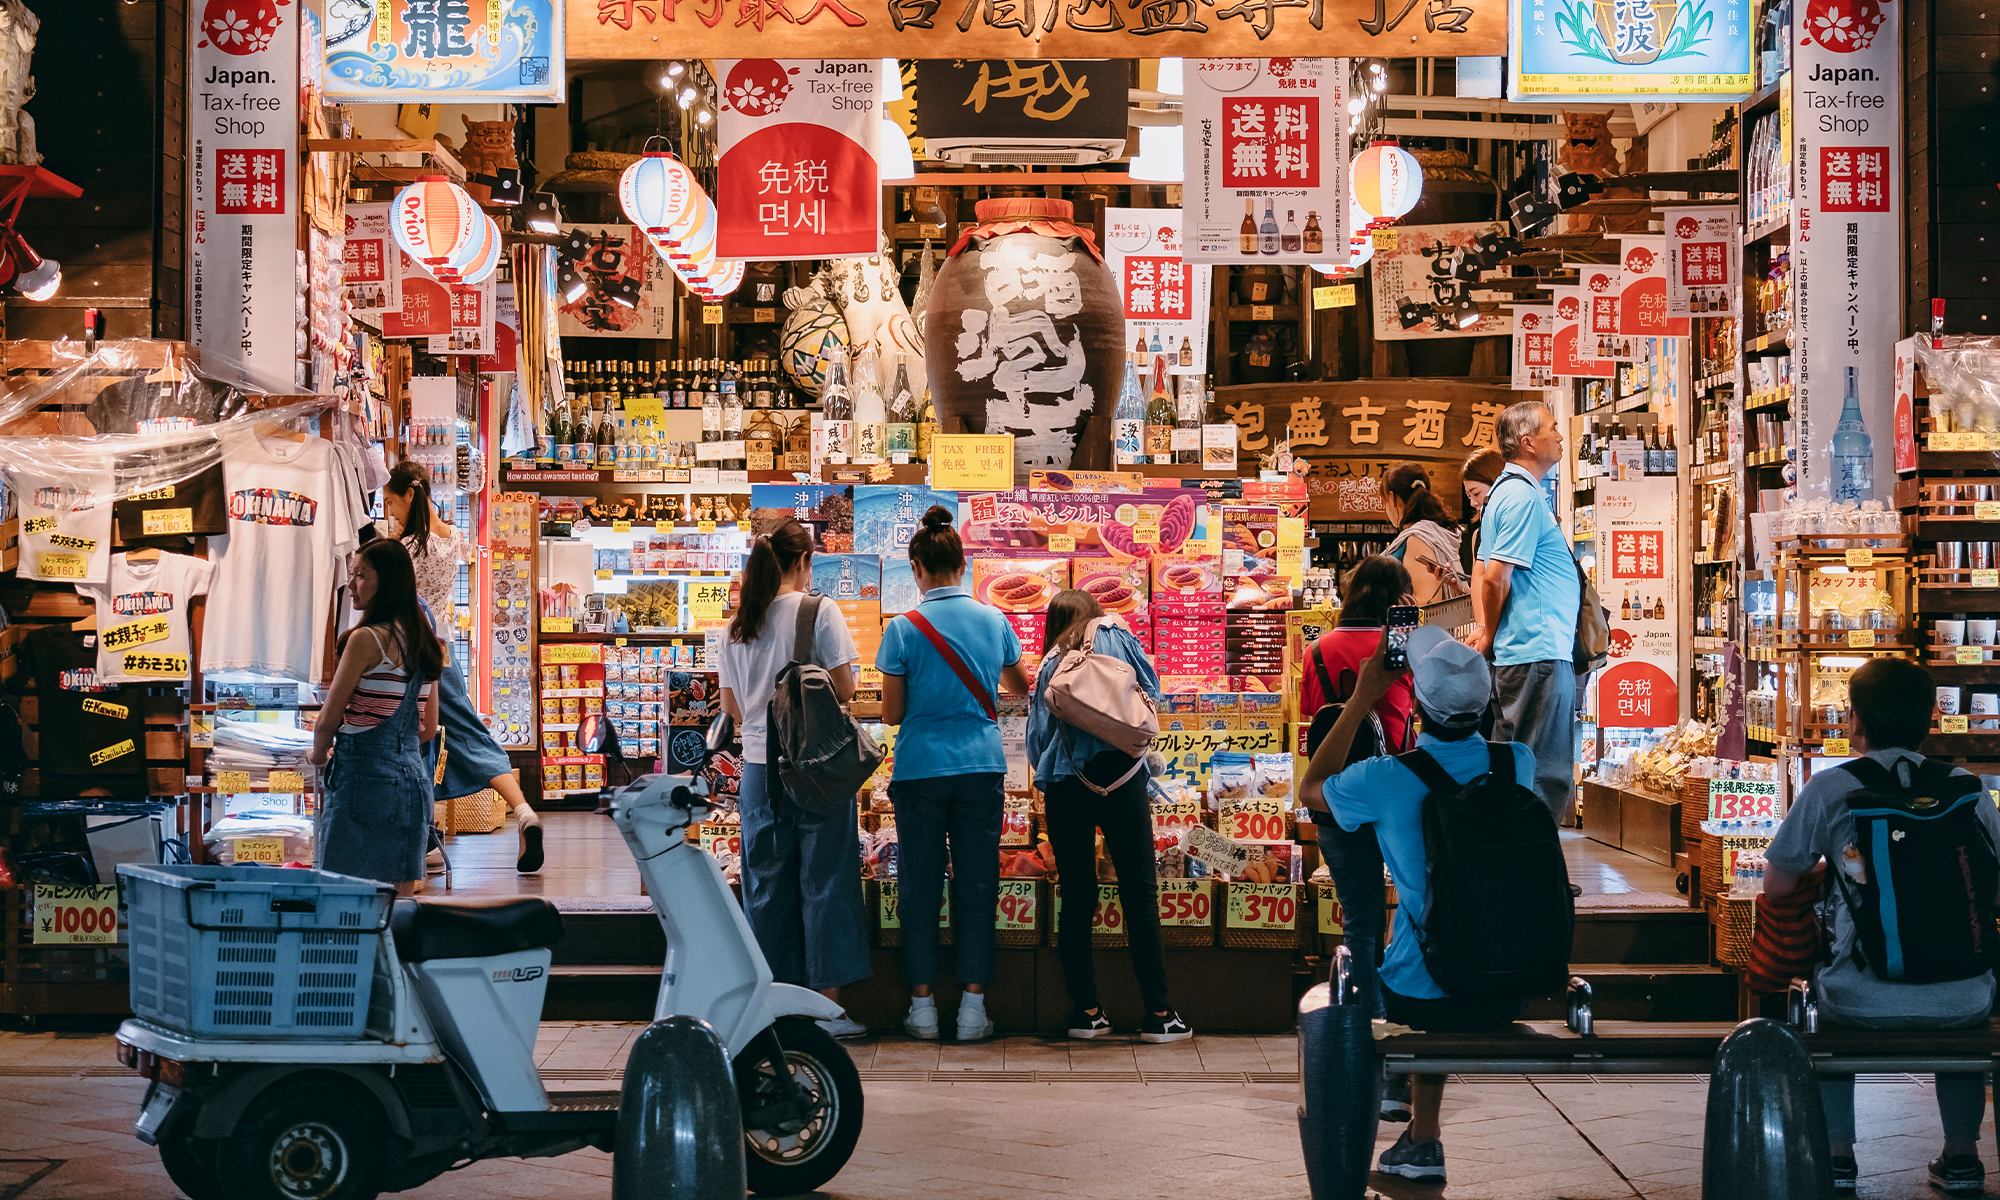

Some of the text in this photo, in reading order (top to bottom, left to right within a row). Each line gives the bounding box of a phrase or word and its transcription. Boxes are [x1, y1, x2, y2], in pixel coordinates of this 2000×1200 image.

[401, 0, 478, 58] 龍
[488, 0, 500, 43] 風味絶佳
[425, 60, 453, 72] たつ
[814, 60, 874, 77] Japan.
[1808, 63, 1880, 86] Japan.
[205, 65, 276, 88] Japan.
[1278, 78, 1317, 89] 免税 면세
[1522, 75, 1545, 83] 製造元
[1670, 75, 1749, 85] 波照間酒造所
[807, 79, 874, 94] Tax-free
[199, 93, 281, 111] Tax-free
[831, 96, 874, 114] Shop
[1803, 90, 1885, 109] Tax-free
[214, 116, 265, 138] Shop
[1231, 103, 1309, 140] 送料
[1818, 113, 1870, 136] Shop
[222, 153, 278, 179] 送料
[1231, 142, 1310, 179] 無料
[1826, 151, 1883, 178] 送料
[757, 159, 830, 196] 免税
[222, 181, 278, 208] 無料
[668, 168, 687, 213] Orion
[1236, 190, 1308, 198] 期間限定キャンペーン中
[1826, 179, 1883, 207] 無料
[404, 196, 425, 247] Orion
[758, 199, 828, 237] 면세
[1686, 245, 1721, 262] 送料
[1130, 260, 1185, 287] 送料
[1686, 263, 1722, 281] 無料
[240, 224, 253, 357] 期間限定キャンペーン中。
[1846, 222, 1859, 355] 期間限定キャンペーン中。
[401, 292, 430, 309] 免税
[1130, 287, 1185, 314] 無料
[401, 311, 430, 328] 면세
[942, 445, 1005, 454] TAX FREE
[941, 459, 1004, 471] 免税 면세
[506, 472, 599, 482] How about awamori tasting?
[1000, 489, 1028, 503] 沖縄
[232, 494, 313, 524] OKINAWA
[794, 490, 811, 522] 沖縄
[898, 491, 914, 522] 沖縄
[971, 496, 996, 521] 元祖
[998, 502, 1112, 526] 紅いもタルト
[146, 522, 180, 532] ¥2,160
[49, 533, 96, 550] #双子コーデ
[1617, 533, 1659, 553] 送料
[40, 566, 75, 576] ¥2,160
[840, 559, 851, 579] 沖縄
[1617, 554, 1659, 574] 無料
[115, 595, 172, 613] OKINAWA
[1644, 630, 1672, 639] Japan.
[1641, 640, 1673, 648] Tax-free
[1652, 648, 1673, 657] Shop
[123, 654, 188, 672] #おそろい
[855, 691, 877, 699] SPAM
[1617, 678, 1652, 696] 免税
[1618, 698, 1651, 717] 면세
[1711, 781, 1776, 795] 沖縄限定梅酒
[261, 796, 288, 807] Shop
[241, 842, 278, 850] キッズTシャツ
[1724, 837, 1773, 850] 沖縄限定
[236, 851, 271, 861] ¥2,160
[1160, 880, 1200, 892] まい棒
[1229, 884, 1293, 896] ファミリーパック
[1160, 893, 1210, 919] 550
